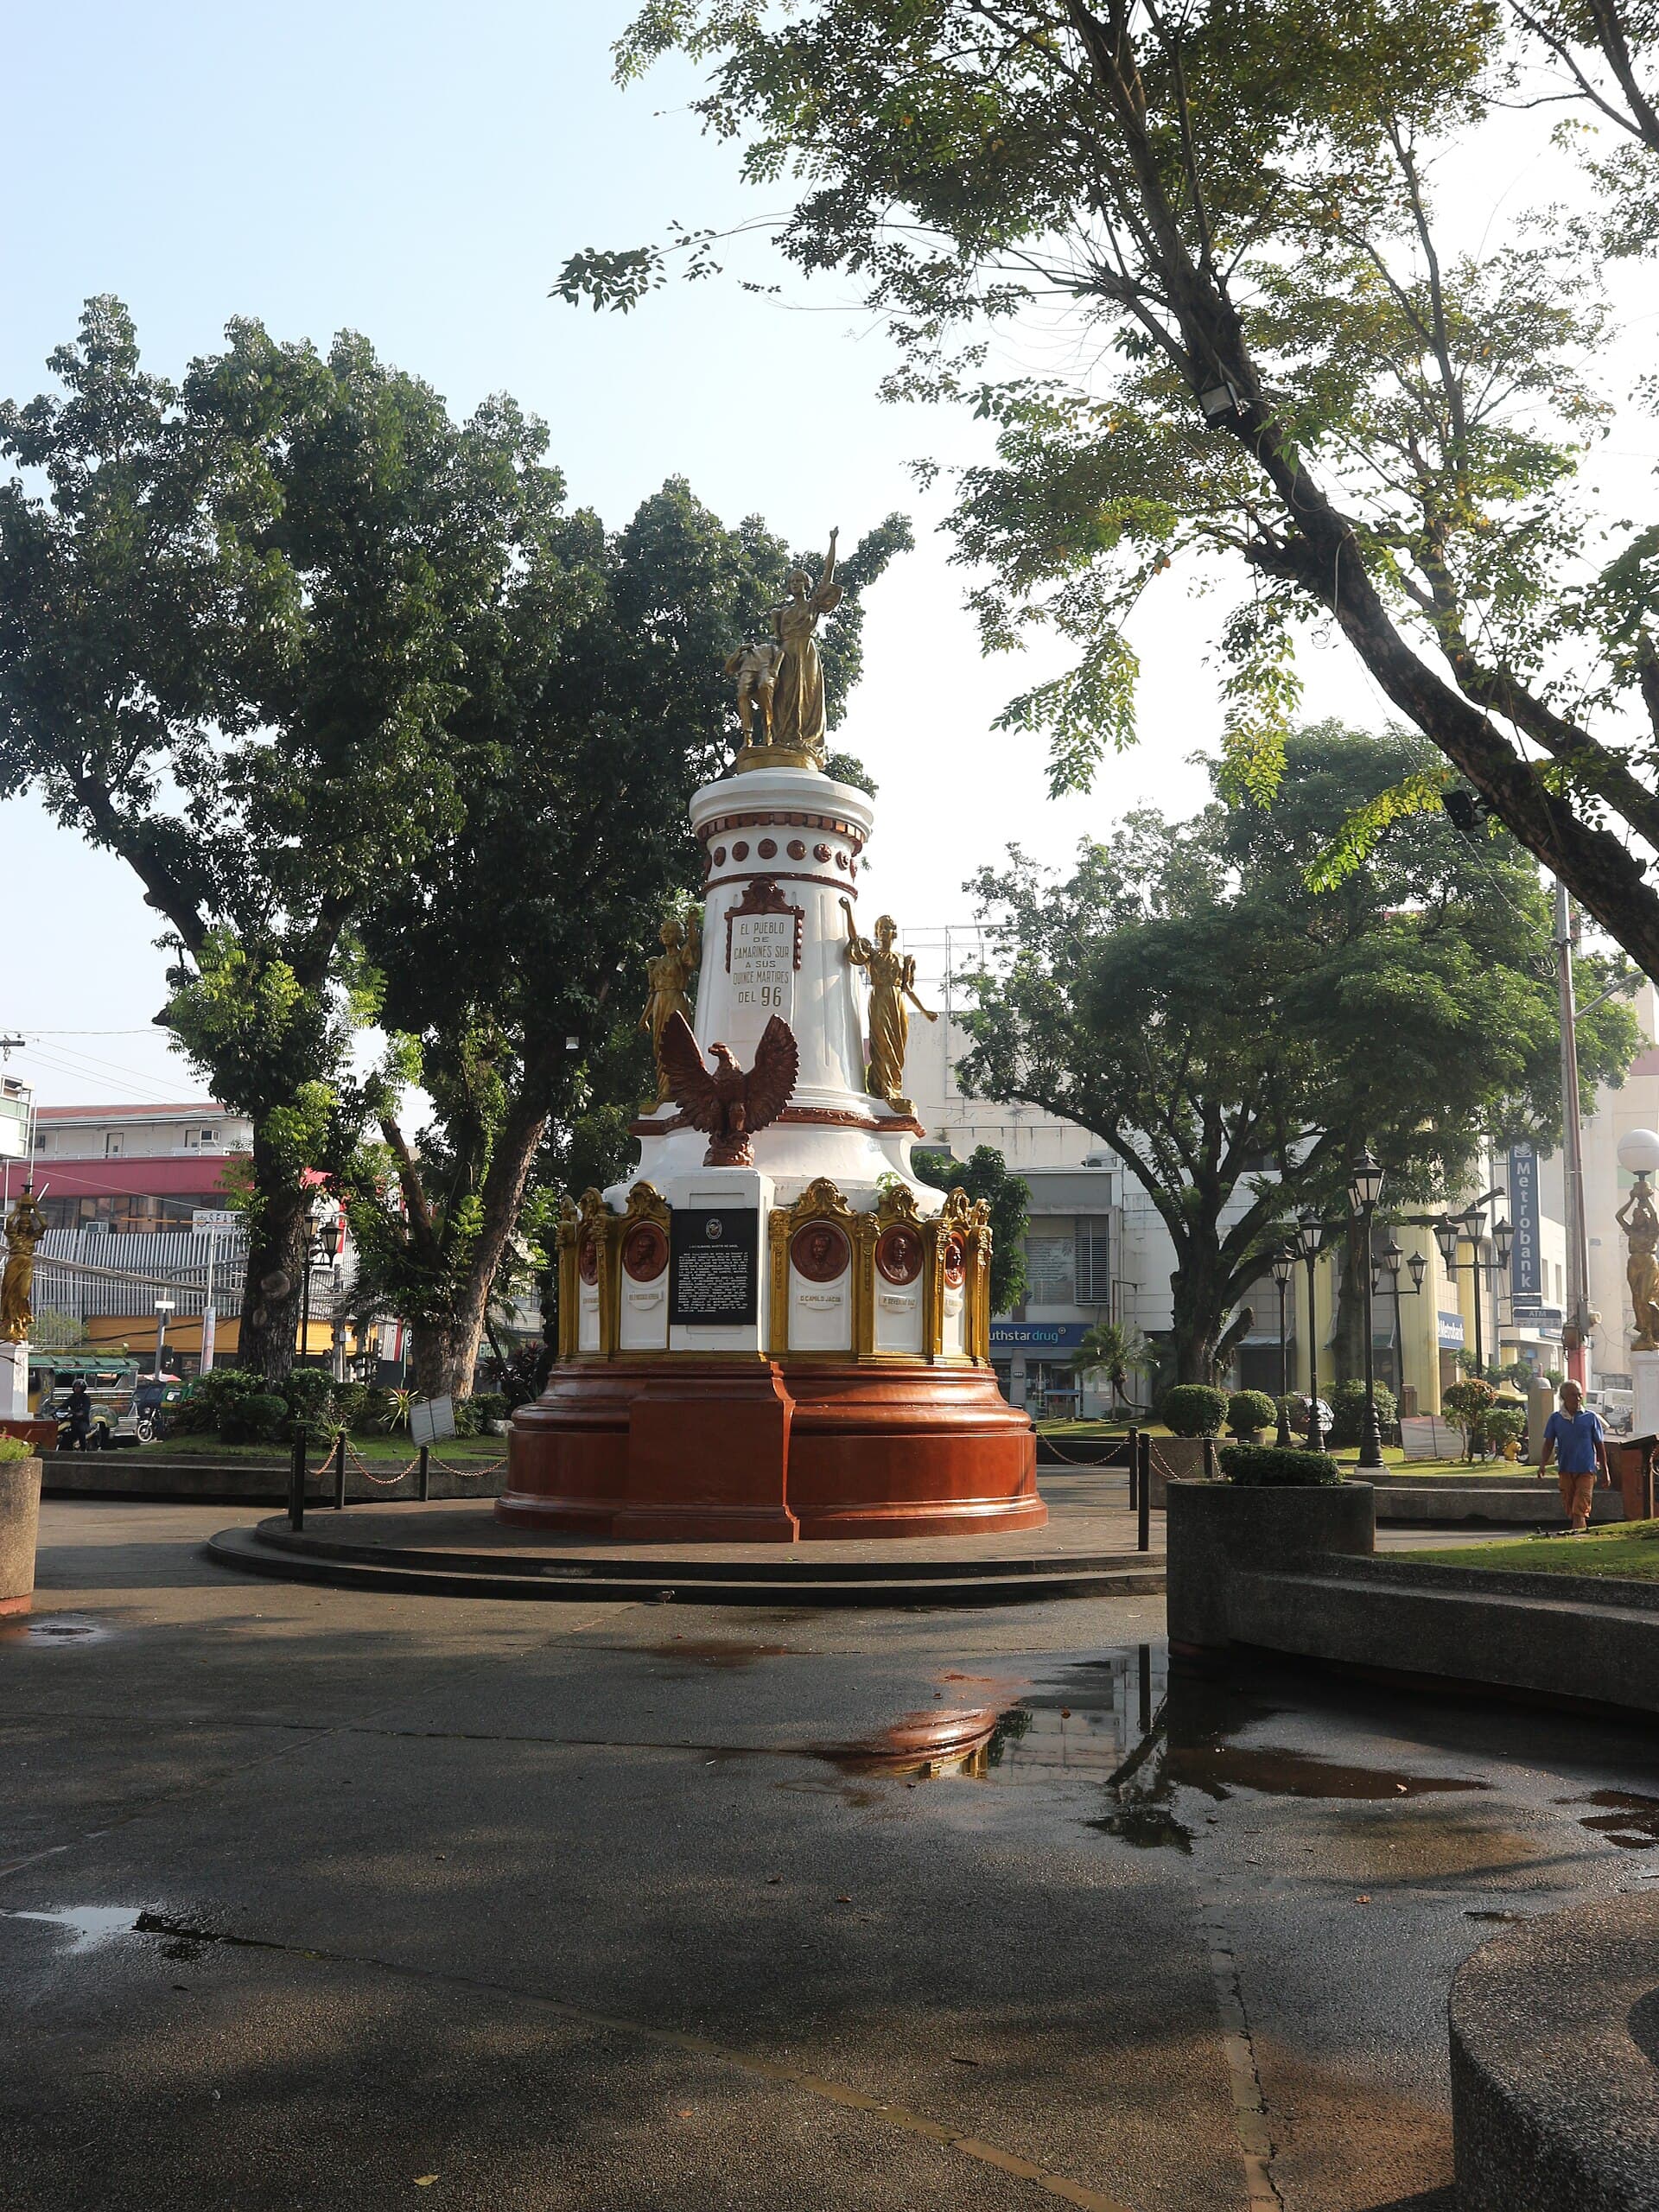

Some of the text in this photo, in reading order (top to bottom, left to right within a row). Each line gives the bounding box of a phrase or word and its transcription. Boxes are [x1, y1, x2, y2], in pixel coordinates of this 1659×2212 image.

[741, 922, 785, 935] EL PUEBLO
[734, 945, 790, 960] CAMARINES SUR
[756, 970, 789, 984] MARTIRES
[739, 986, 782, 1007] DEL 96
[1516, 1161, 1532, 1287] Metrobank
[1440, 1319, 1465, 1341] Metrobank
